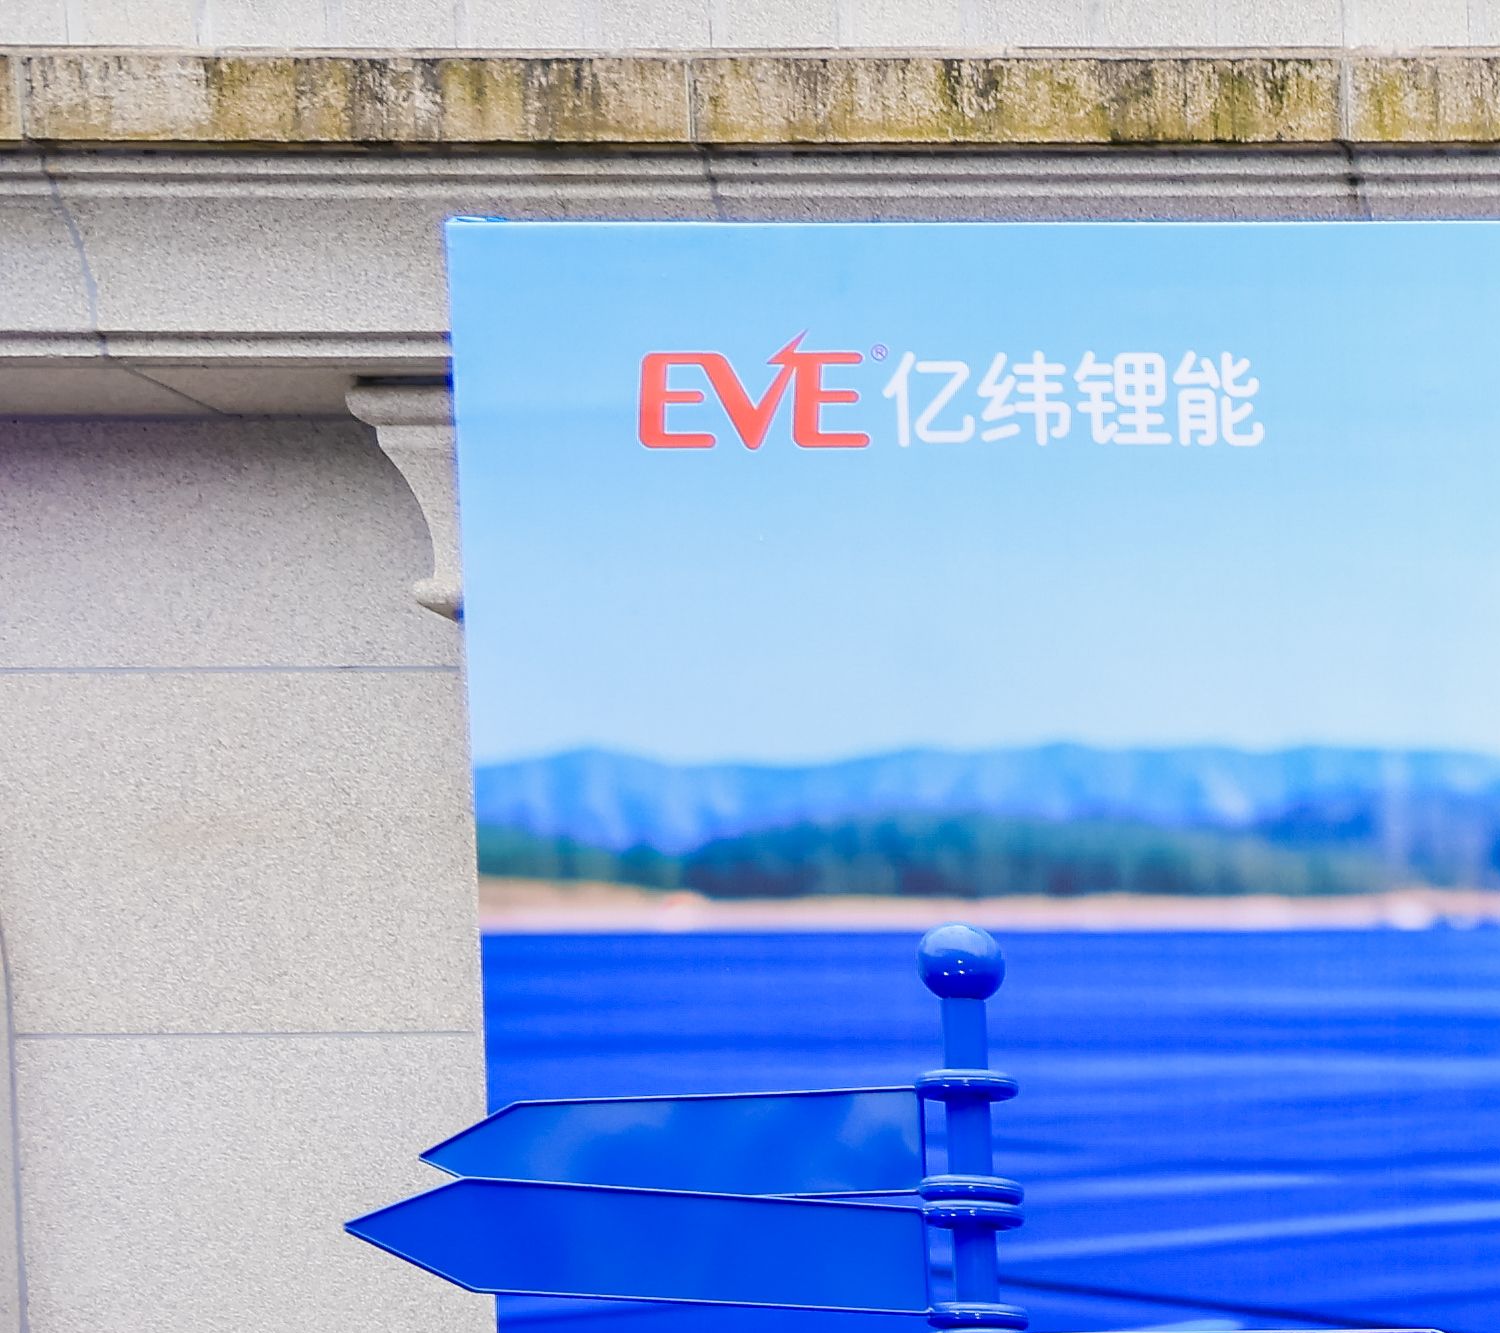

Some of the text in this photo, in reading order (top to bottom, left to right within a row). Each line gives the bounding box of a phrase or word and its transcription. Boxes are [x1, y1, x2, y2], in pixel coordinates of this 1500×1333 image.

[639, 329, 1264, 450] EVE 亿纬锂能
